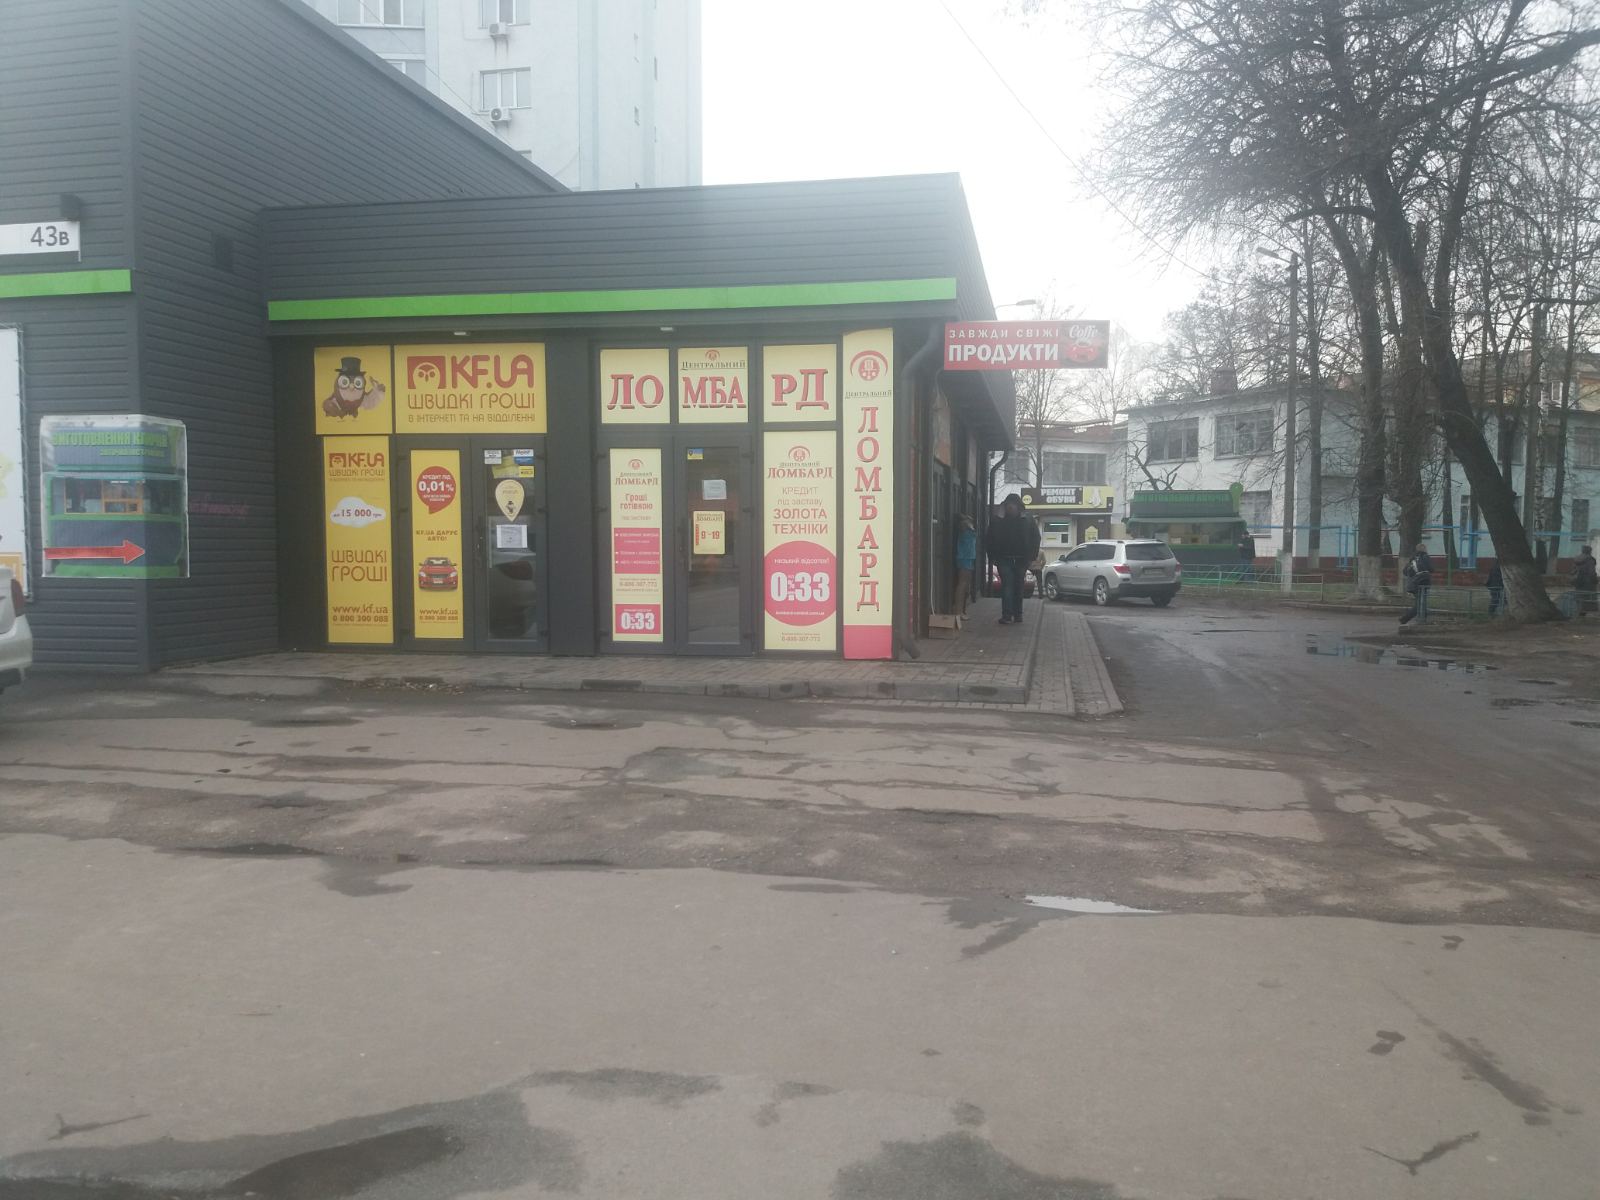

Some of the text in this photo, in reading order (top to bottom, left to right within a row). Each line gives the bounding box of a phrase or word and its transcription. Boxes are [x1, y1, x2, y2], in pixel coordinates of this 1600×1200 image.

[949, 329, 1059, 338] ЗАВЖДИ СВІЖІ
[948, 343, 1058, 364] ПРОДУКТИ
[407, 392, 535, 409] ШВИДКІ ГРОШІ
[460, 413, 470, 422] ТА
[472, 413, 485, 422] НА
[1041, 488, 1077, 496] РЕМОНТ
[773, 508, 828, 519] ЗОЛОТА
[854, 406, 882, 612] ЛОМБАРД
[772, 523, 828, 534] ТЕХНІКИ
[331, 550, 387, 563] ШВИДКІ
[332, 566, 388, 581] ГРОШІ
[332, 603, 388, 614] www.kf.ua
